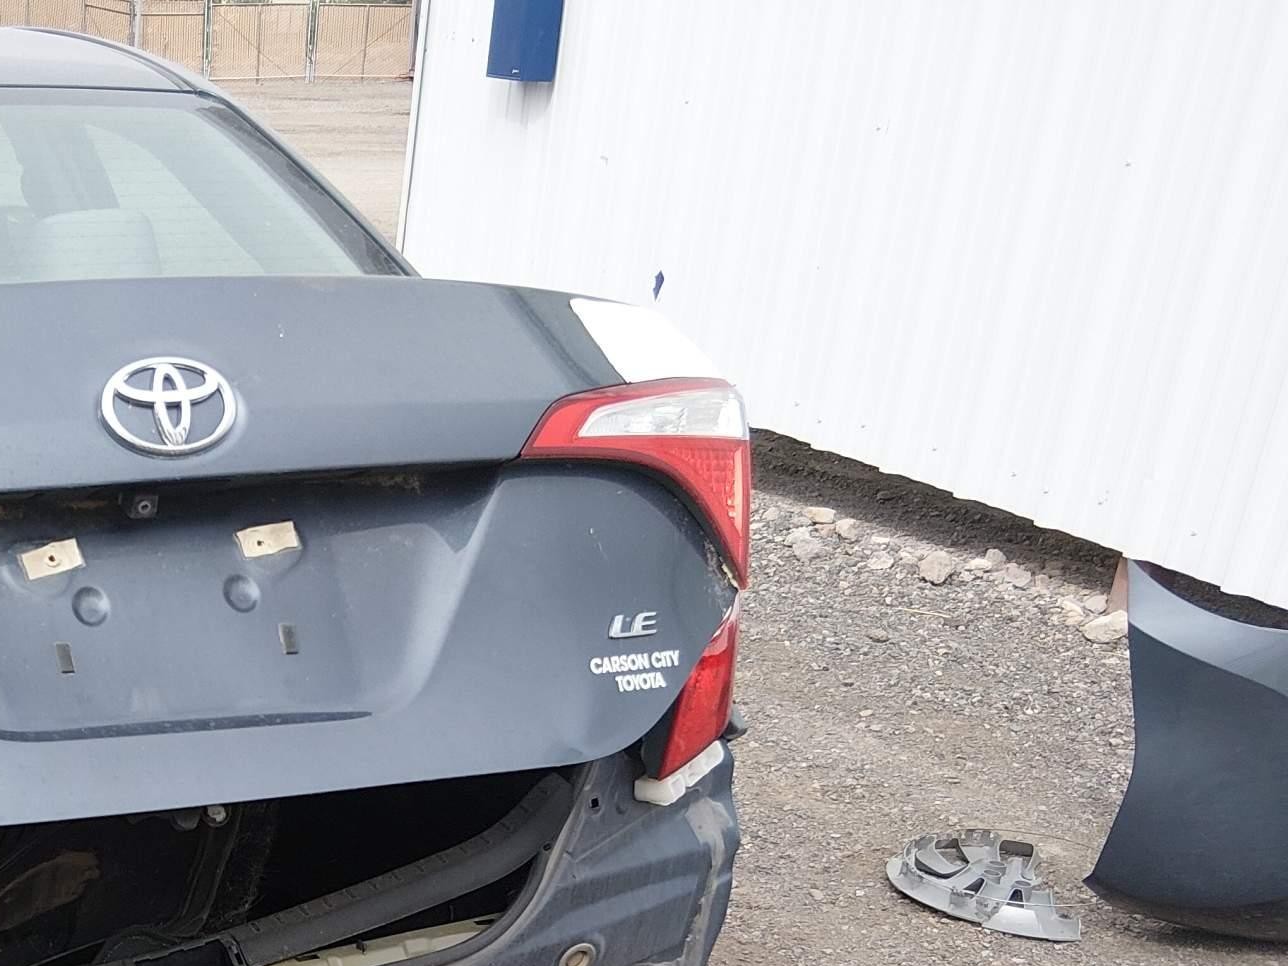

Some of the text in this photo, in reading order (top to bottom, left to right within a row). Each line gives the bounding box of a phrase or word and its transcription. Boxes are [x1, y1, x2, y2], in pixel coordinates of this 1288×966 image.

[608, 611, 657, 639] LE
[590, 650, 680, 675] CARSON CITY
[615, 671, 667, 693] TOYOTA
